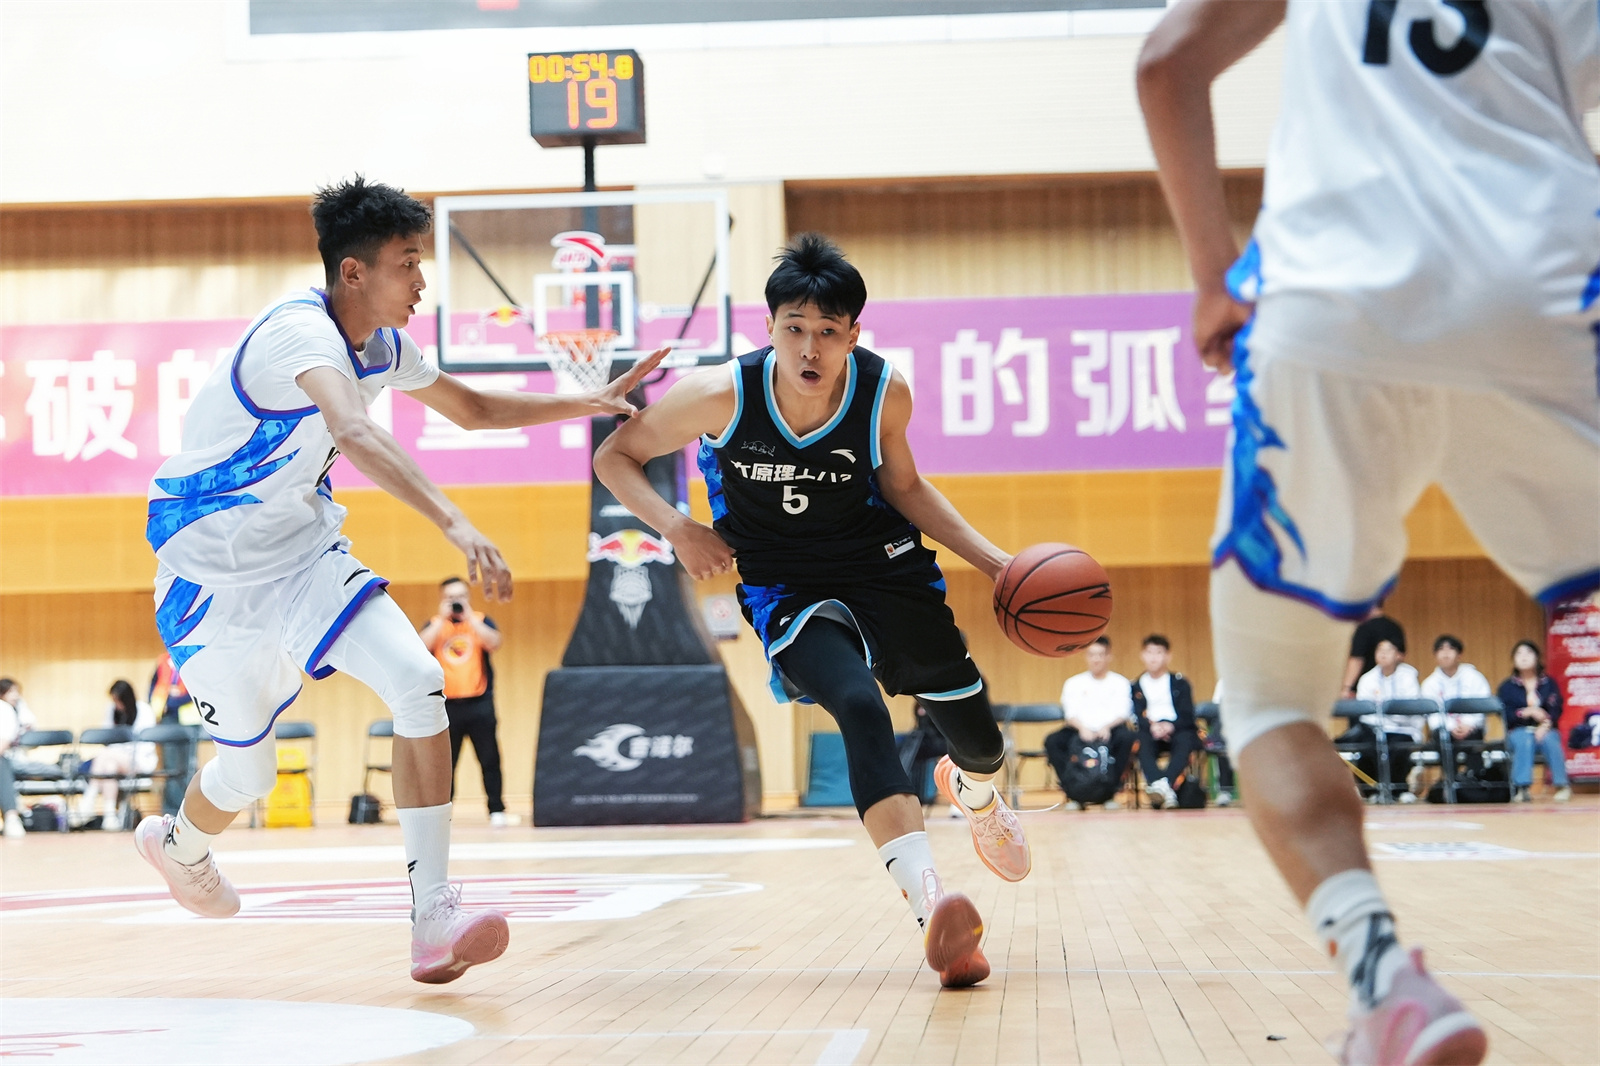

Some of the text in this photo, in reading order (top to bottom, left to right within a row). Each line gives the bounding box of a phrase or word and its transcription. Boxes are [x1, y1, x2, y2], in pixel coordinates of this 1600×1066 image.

[529, 53, 634, 83] 00:54.8
[567, 78, 618, 129] 19
[730, 460, 852, 484] 太原理工
[782, 485, 809, 515] 5
[193, 696, 219, 726] 12
